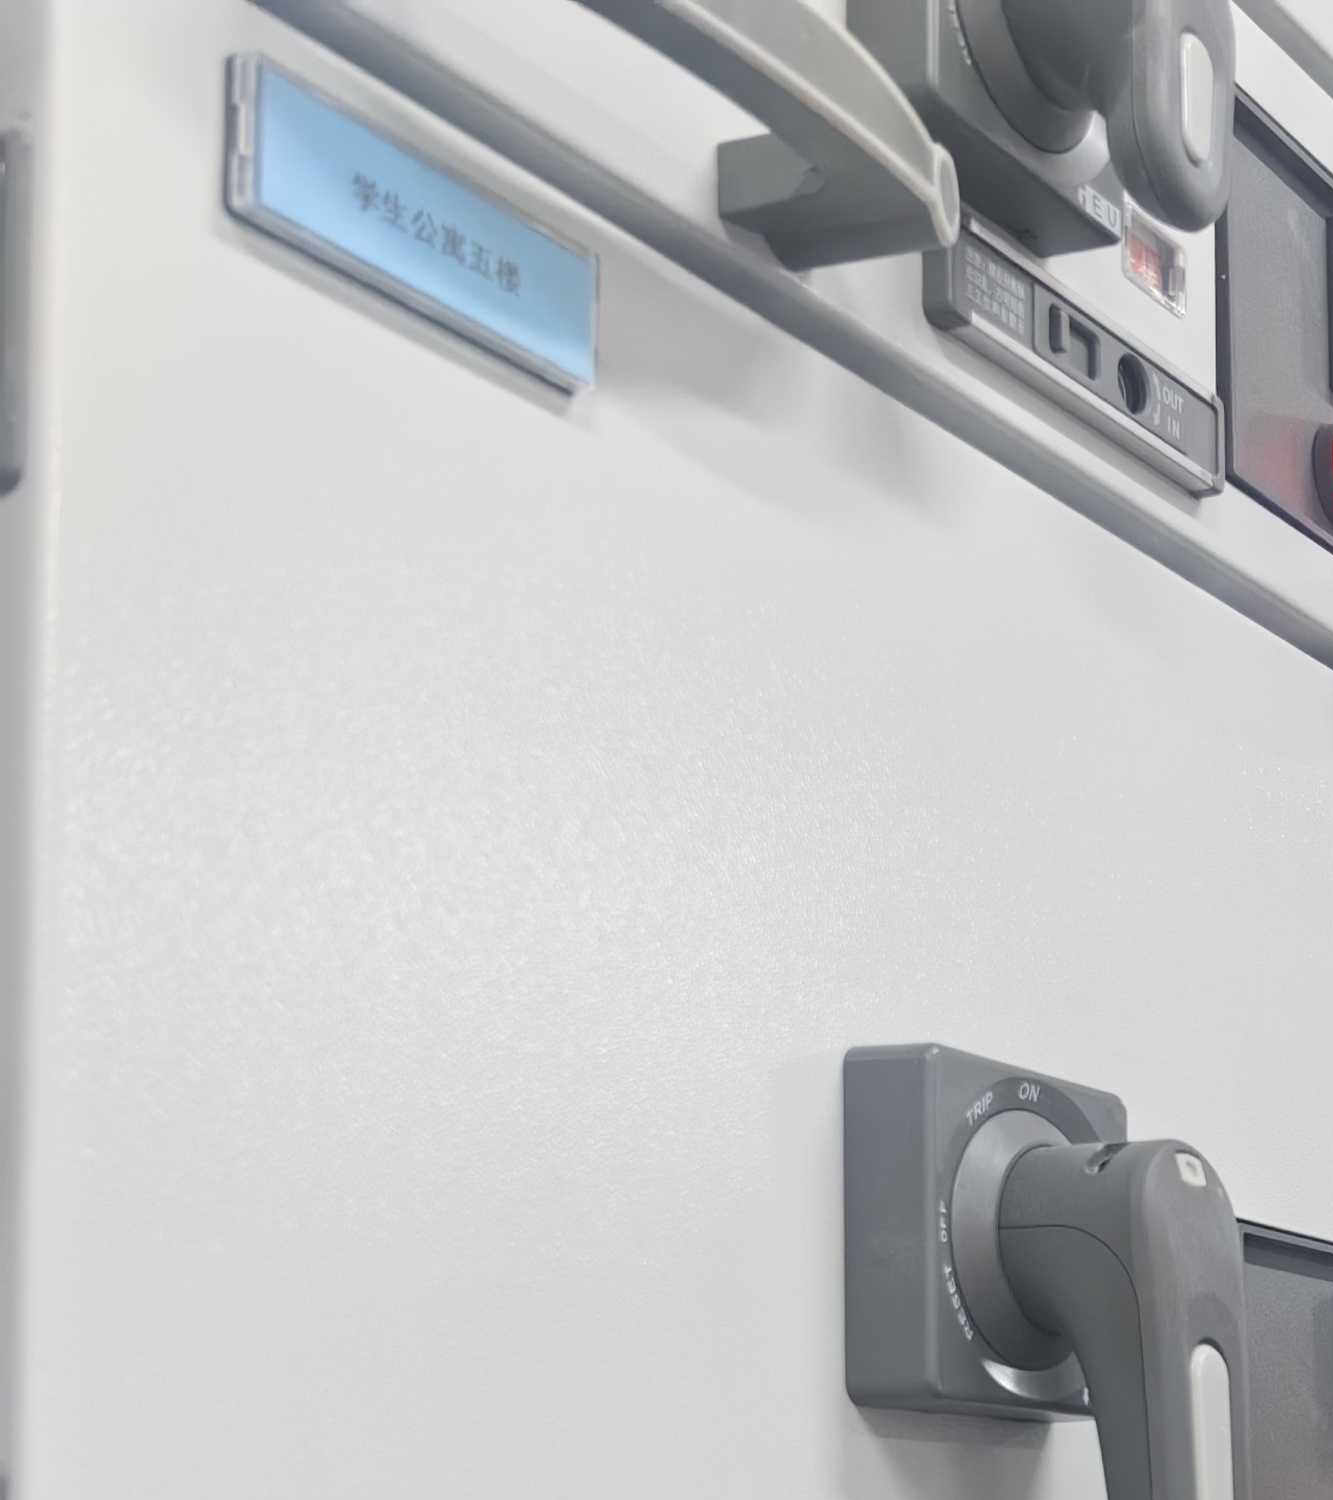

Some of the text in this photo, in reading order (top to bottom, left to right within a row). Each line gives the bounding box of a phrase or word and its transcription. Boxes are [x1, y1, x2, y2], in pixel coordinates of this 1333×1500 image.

[352, 172, 521, 296] 学生公寓五楼
[1162, 386, 1184, 413] OUT
[1167, 416, 1180, 440] IN
[966, 1091, 994, 1126] TRIP
[943, 1261, 974, 1342] RESET
